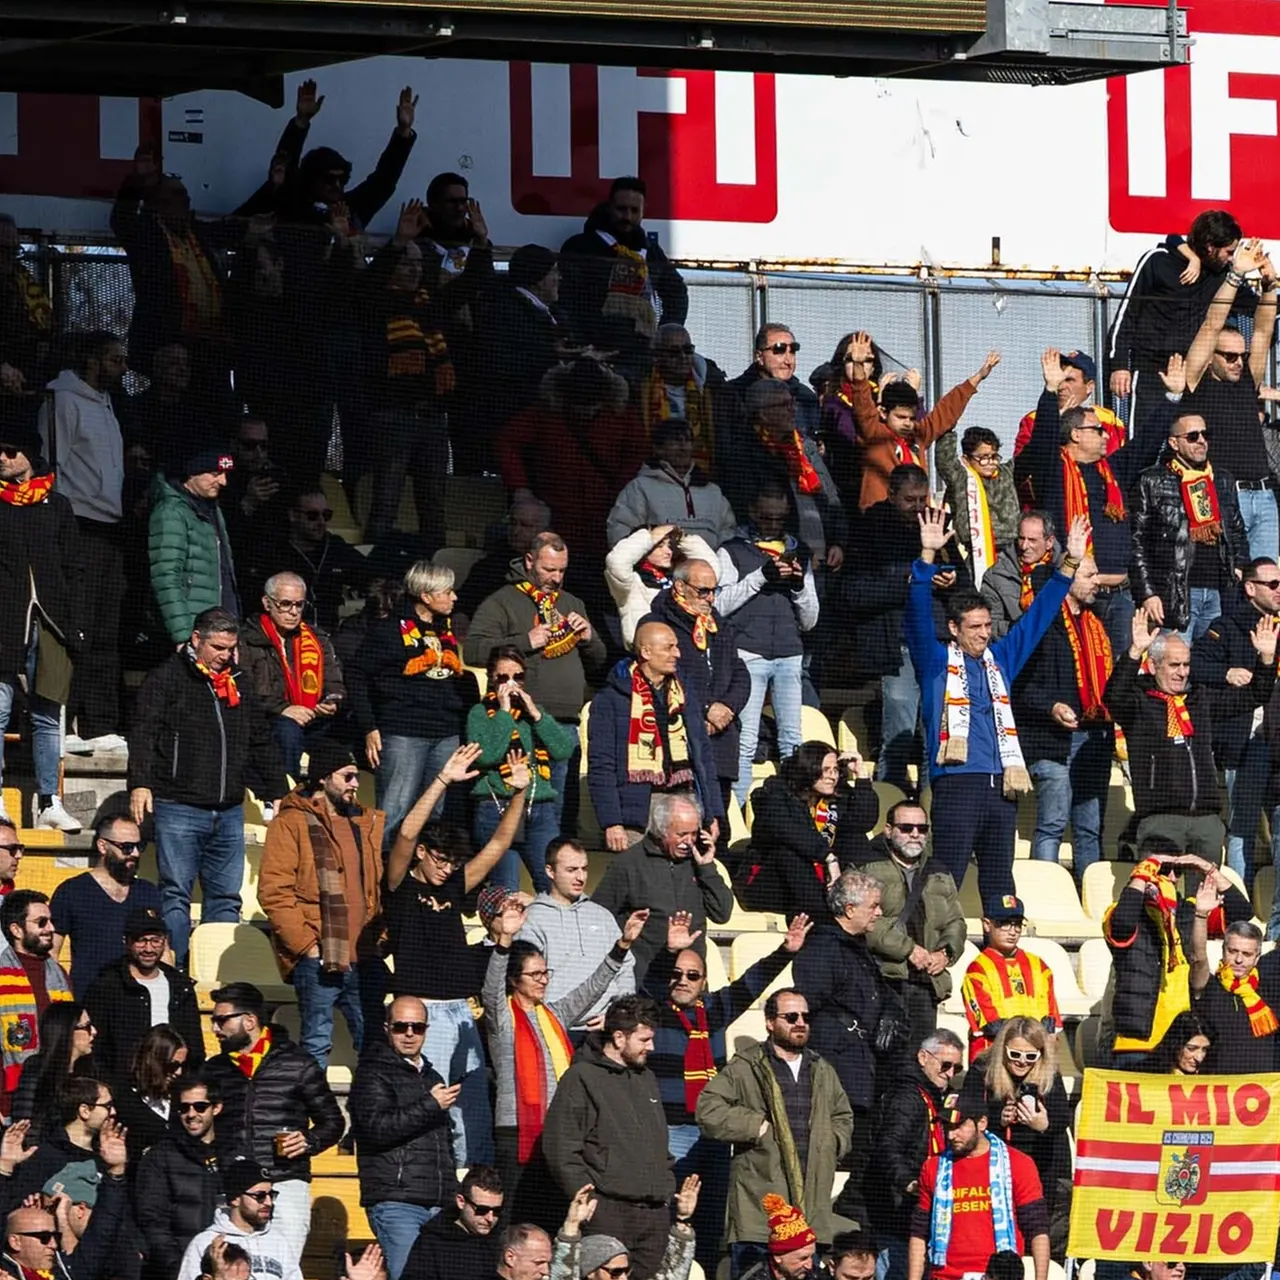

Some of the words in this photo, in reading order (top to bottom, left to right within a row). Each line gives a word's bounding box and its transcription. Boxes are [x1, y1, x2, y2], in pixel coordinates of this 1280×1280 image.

[1105, 1081, 1155, 1125] IL
[1168, 1083, 1271, 1127] MIO
[1095, 1208, 1254, 1256] VIZIO
